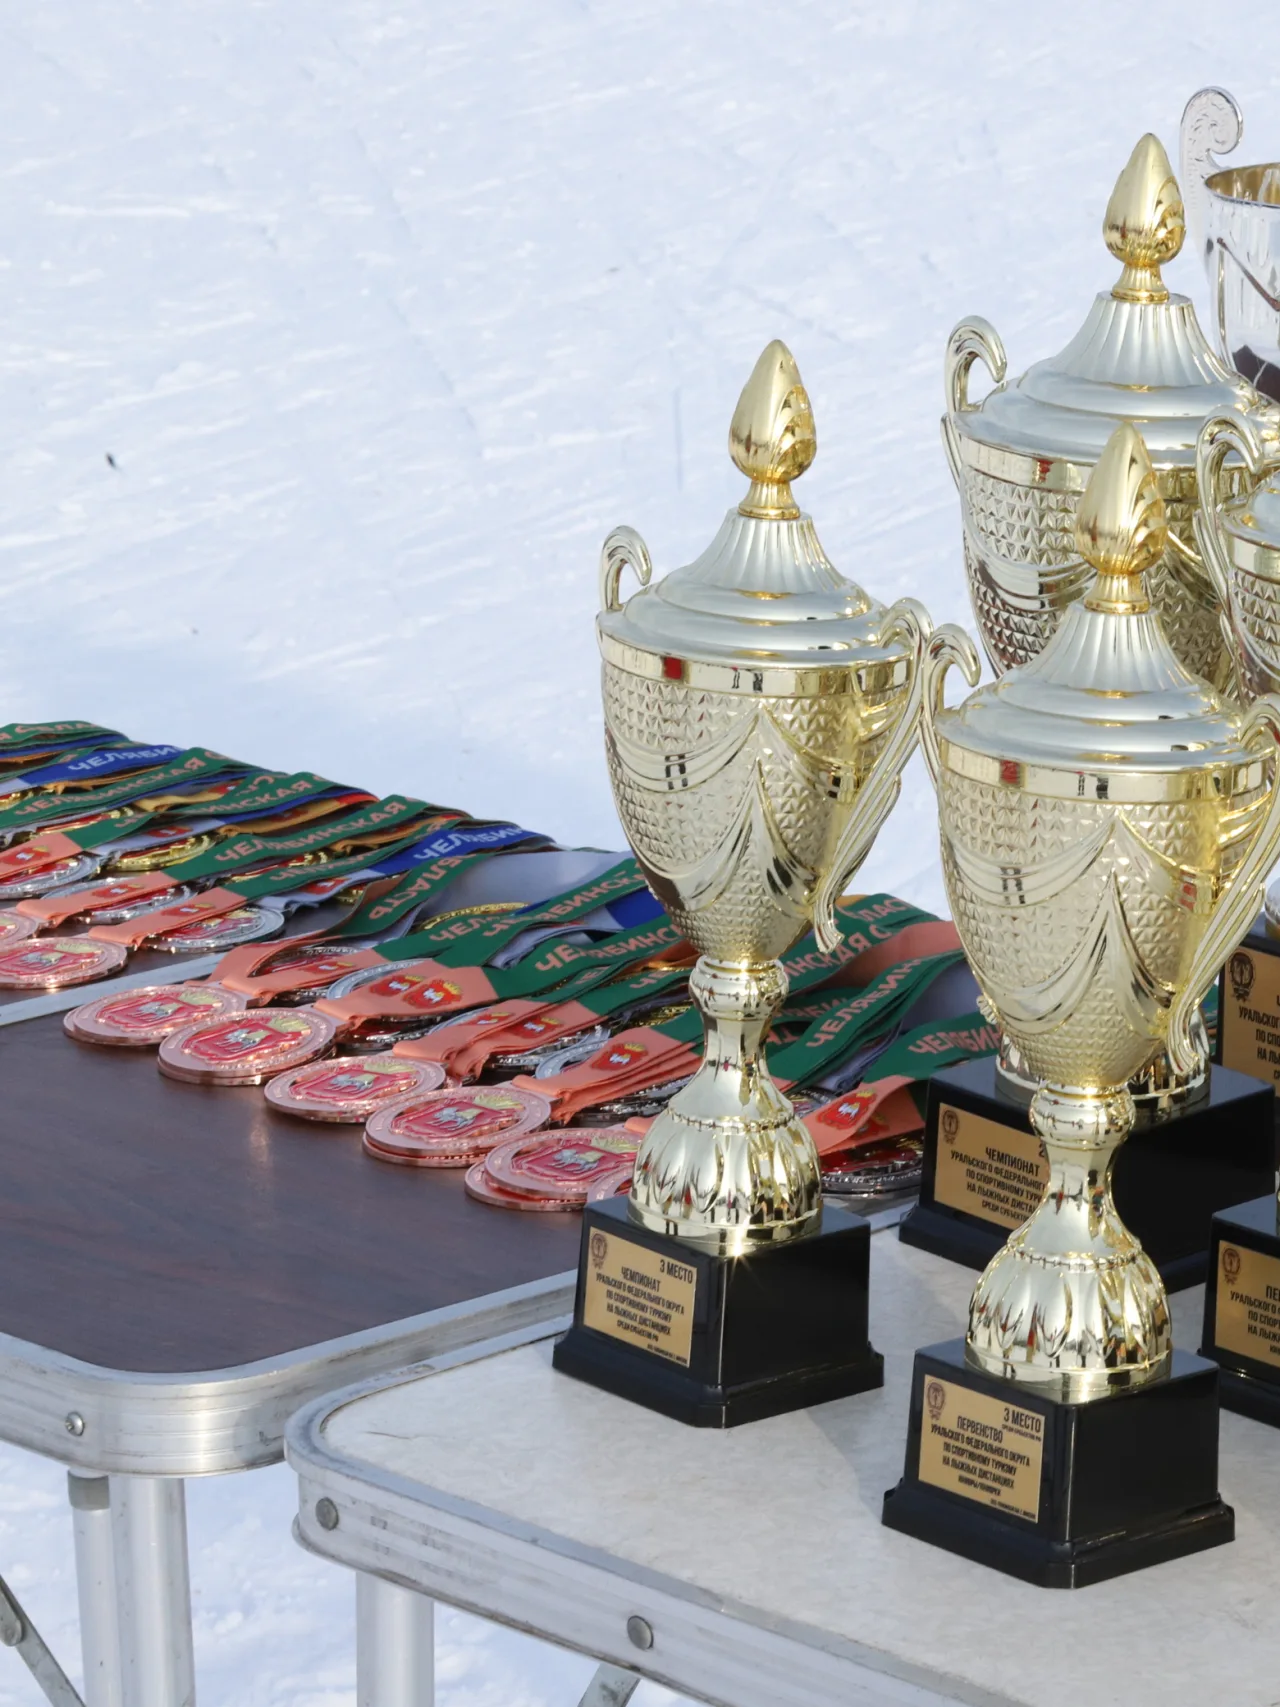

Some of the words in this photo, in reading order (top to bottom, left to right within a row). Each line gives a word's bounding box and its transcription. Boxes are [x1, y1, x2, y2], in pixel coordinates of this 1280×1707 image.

[1256, 1029, 1265, 1042] ПО
[1257, 1047, 1267, 1061] НА
[951, 1150, 992, 1172] УРАЛЬСКОГО
[994, 1168, 1045, 1192] ФЕДЕРАЛЬНОГ
[986, 1147, 1040, 1176] ЧЕМПИОНАТ
[966, 1169, 975, 1179] ПО
[976, 1171, 1024, 1197] СПОРТИВНОМУ
[967, 1182, 976, 1192] НА
[977, 1186, 1009, 1205] ЛЫЖНЫХ
[1000, 1208, 1030, 1221] СУБЪЕКТО
[620, 1265, 661, 1293] ЧЕМПИОНАТ
[659, 1258, 665, 1273] 3
[666, 1261, 693, 1285] МЕСТО
[1230, 1290, 1276, 1315] УРАЛЬСКОГО
[1247, 1309, 1258, 1323] ПО
[1247, 1323, 1258, 1336] НА
[956, 1414, 1003, 1444] ПЕРВЕНСТВО
[1003, 1406, 1010, 1423] 3
[1011, 1409, 1041, 1434] МЕСТО
